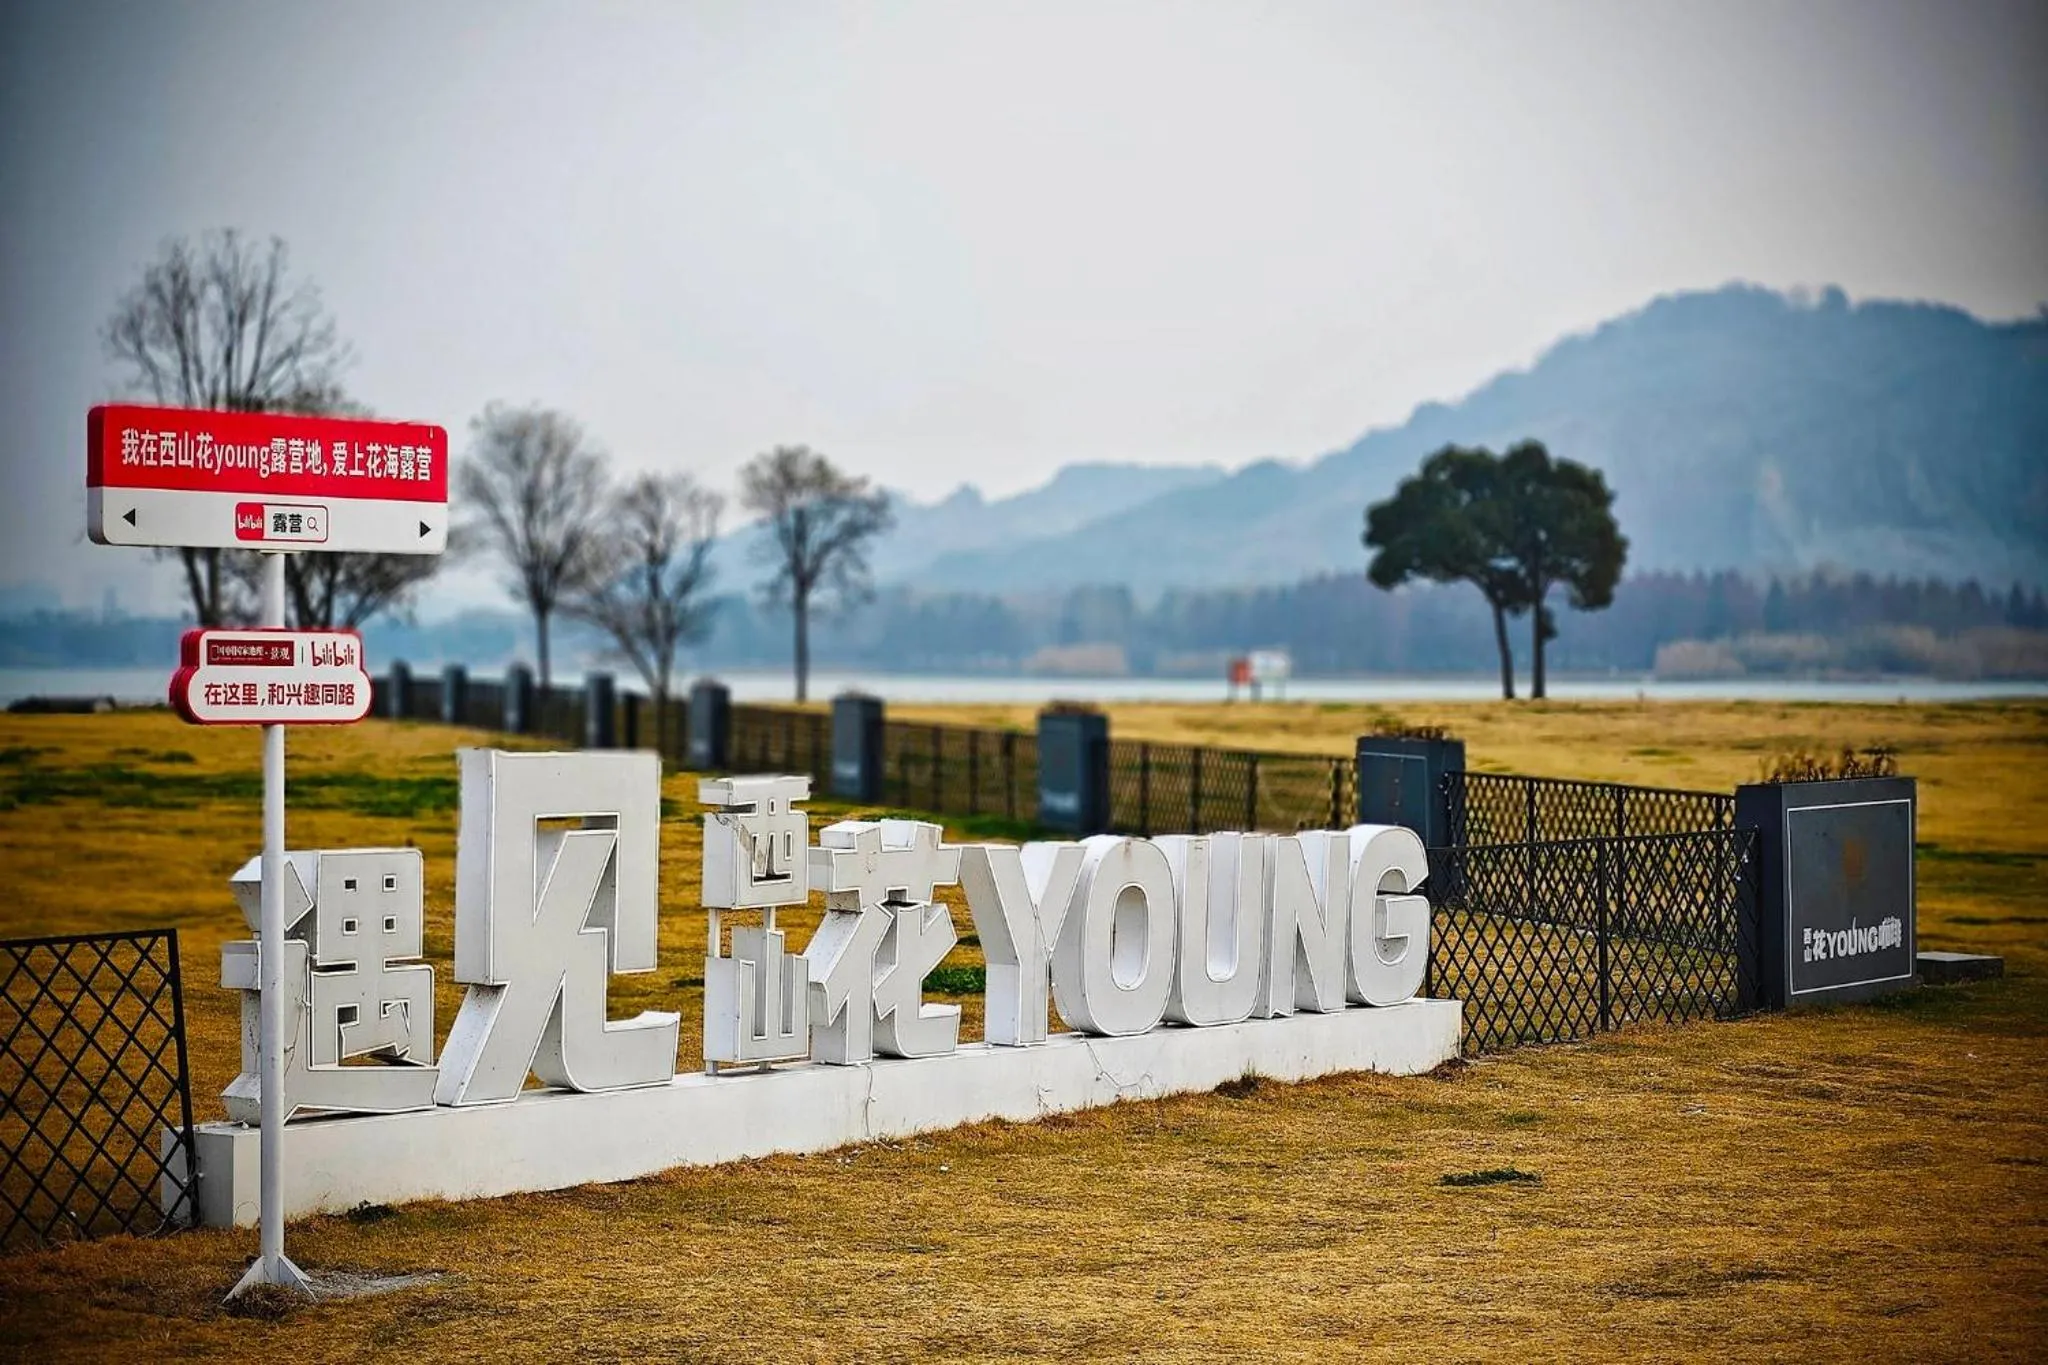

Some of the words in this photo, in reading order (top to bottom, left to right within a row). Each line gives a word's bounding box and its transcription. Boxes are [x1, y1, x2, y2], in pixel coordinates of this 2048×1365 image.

[273, 512, 302, 533] 露营
[311, 640, 355, 667] bilibili
[204, 682, 355, 706] 在这里,和兴趣同路
